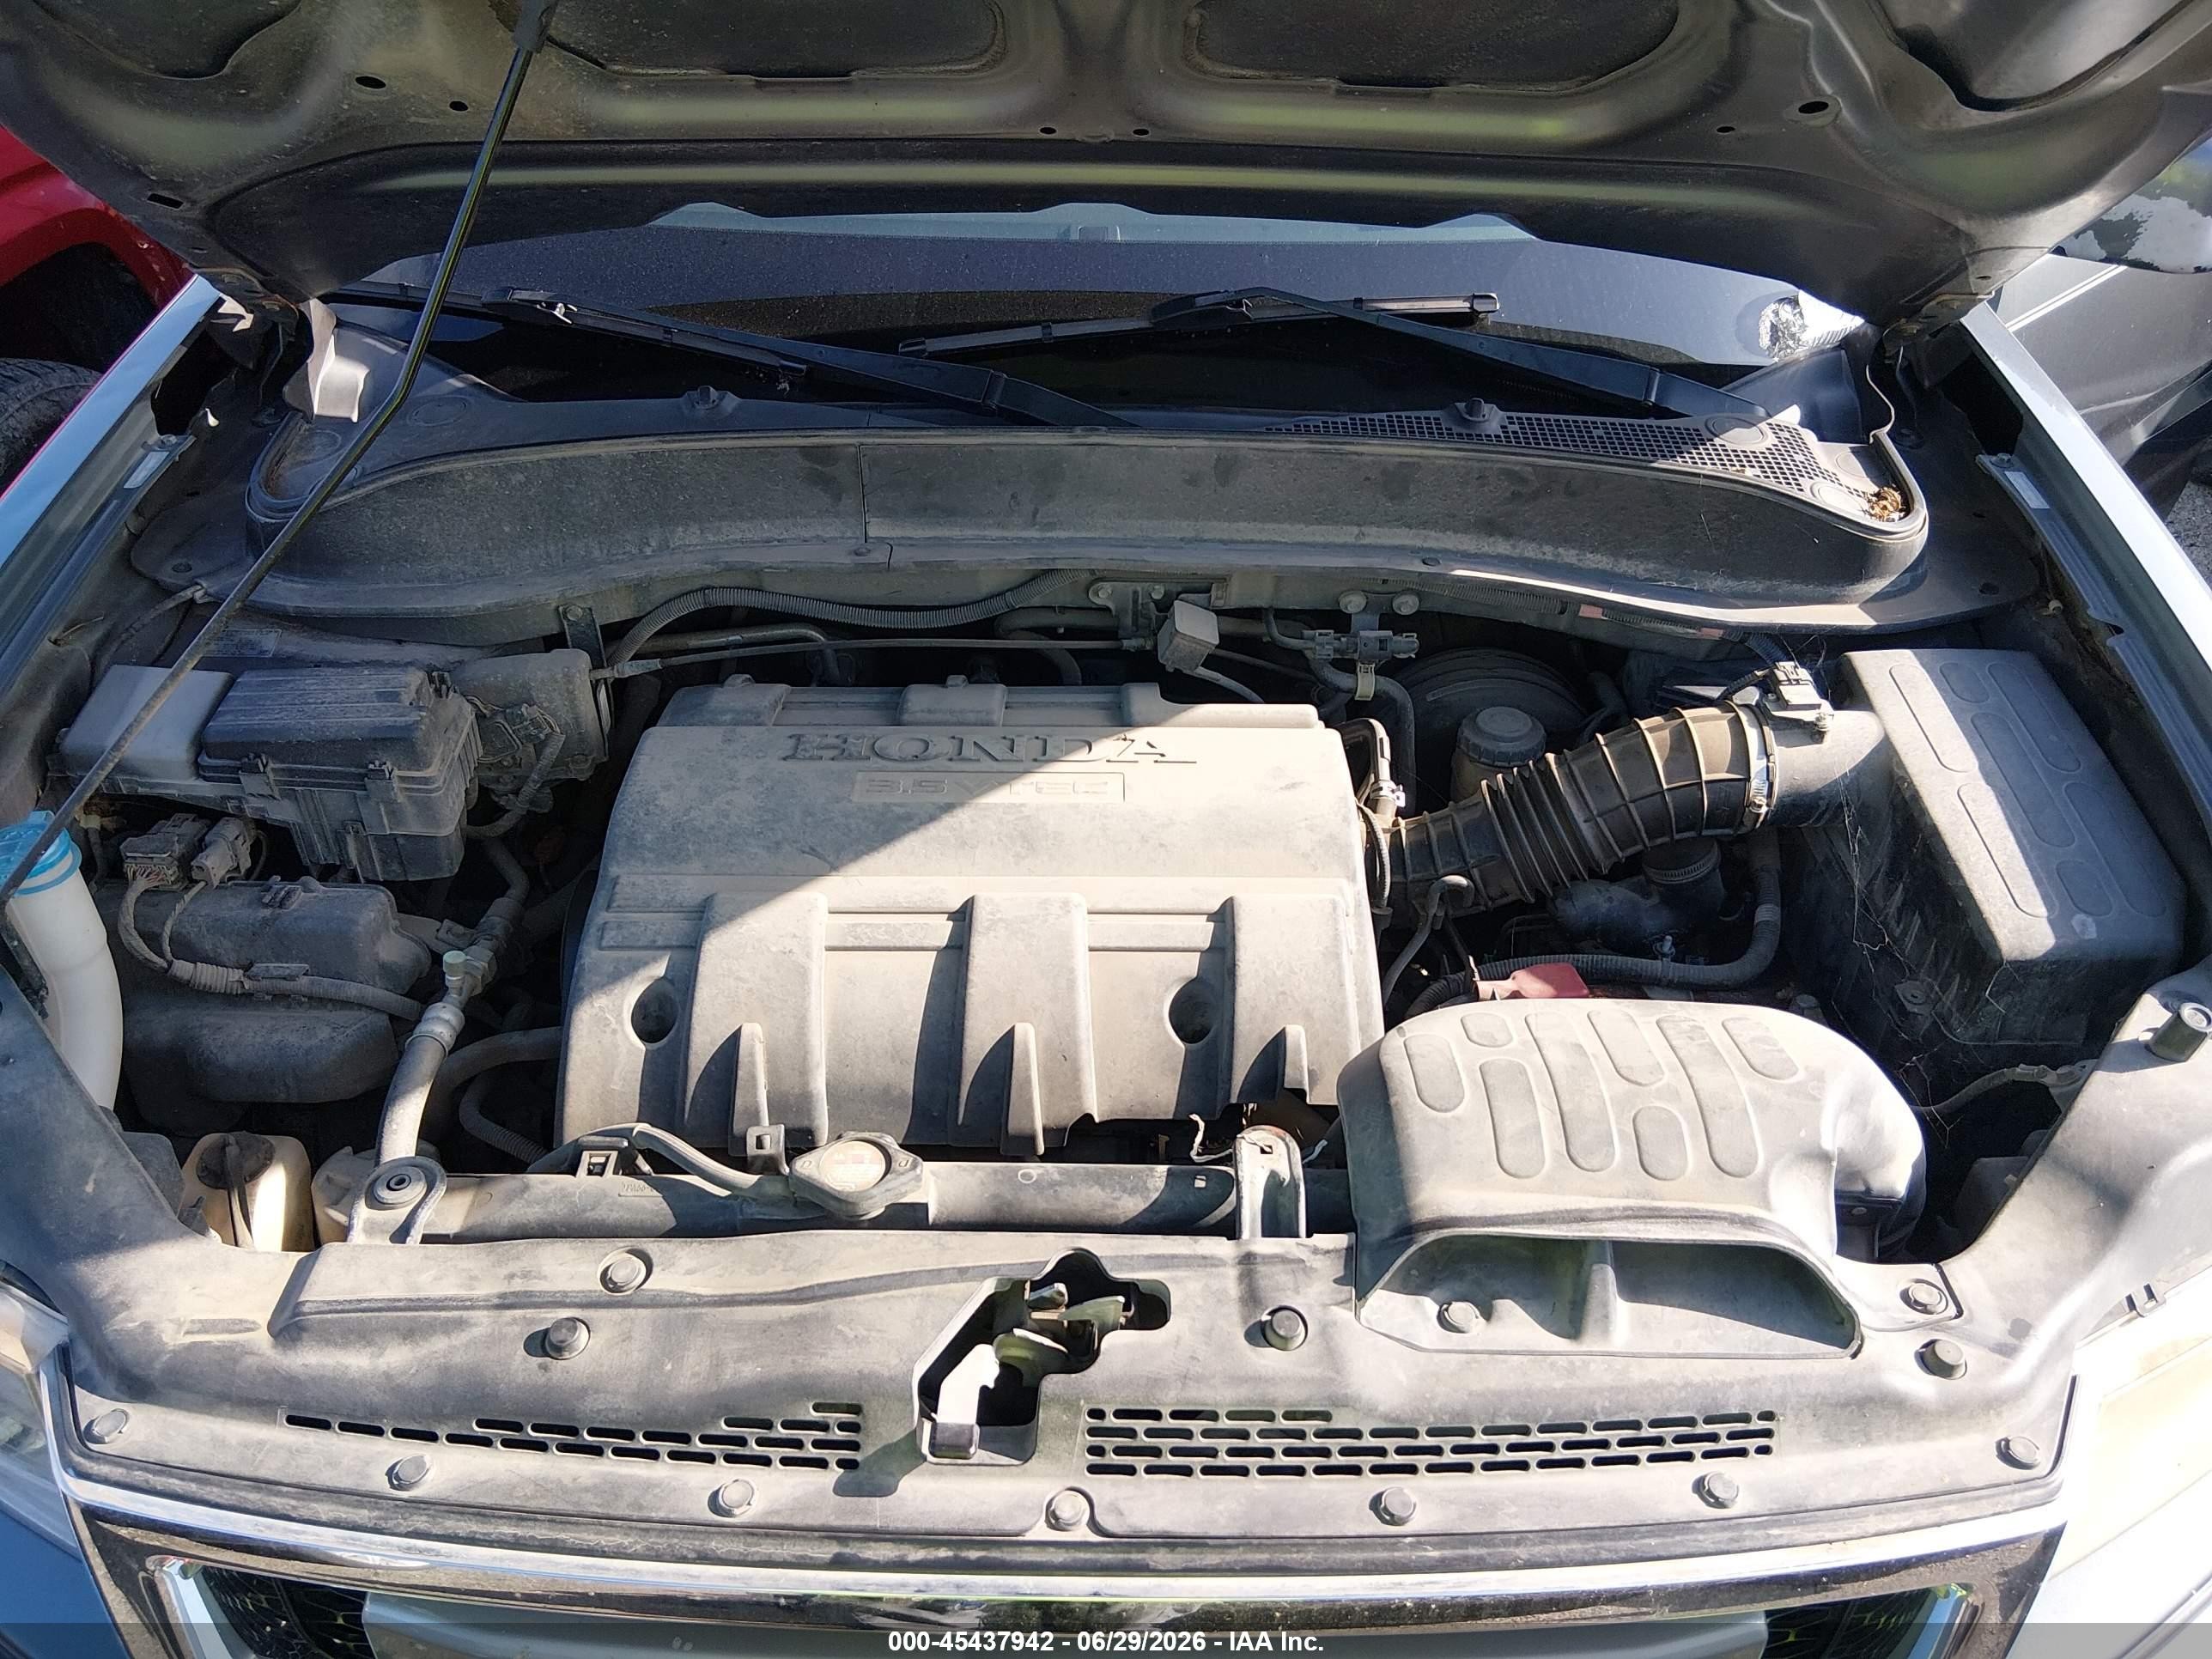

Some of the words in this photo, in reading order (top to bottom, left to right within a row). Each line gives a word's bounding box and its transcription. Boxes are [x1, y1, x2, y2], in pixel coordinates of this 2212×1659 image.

[782, 732, 1197, 763] HONDA
[865, 778, 948, 795] 3.5
[954, 778, 1110, 796] VTEC
